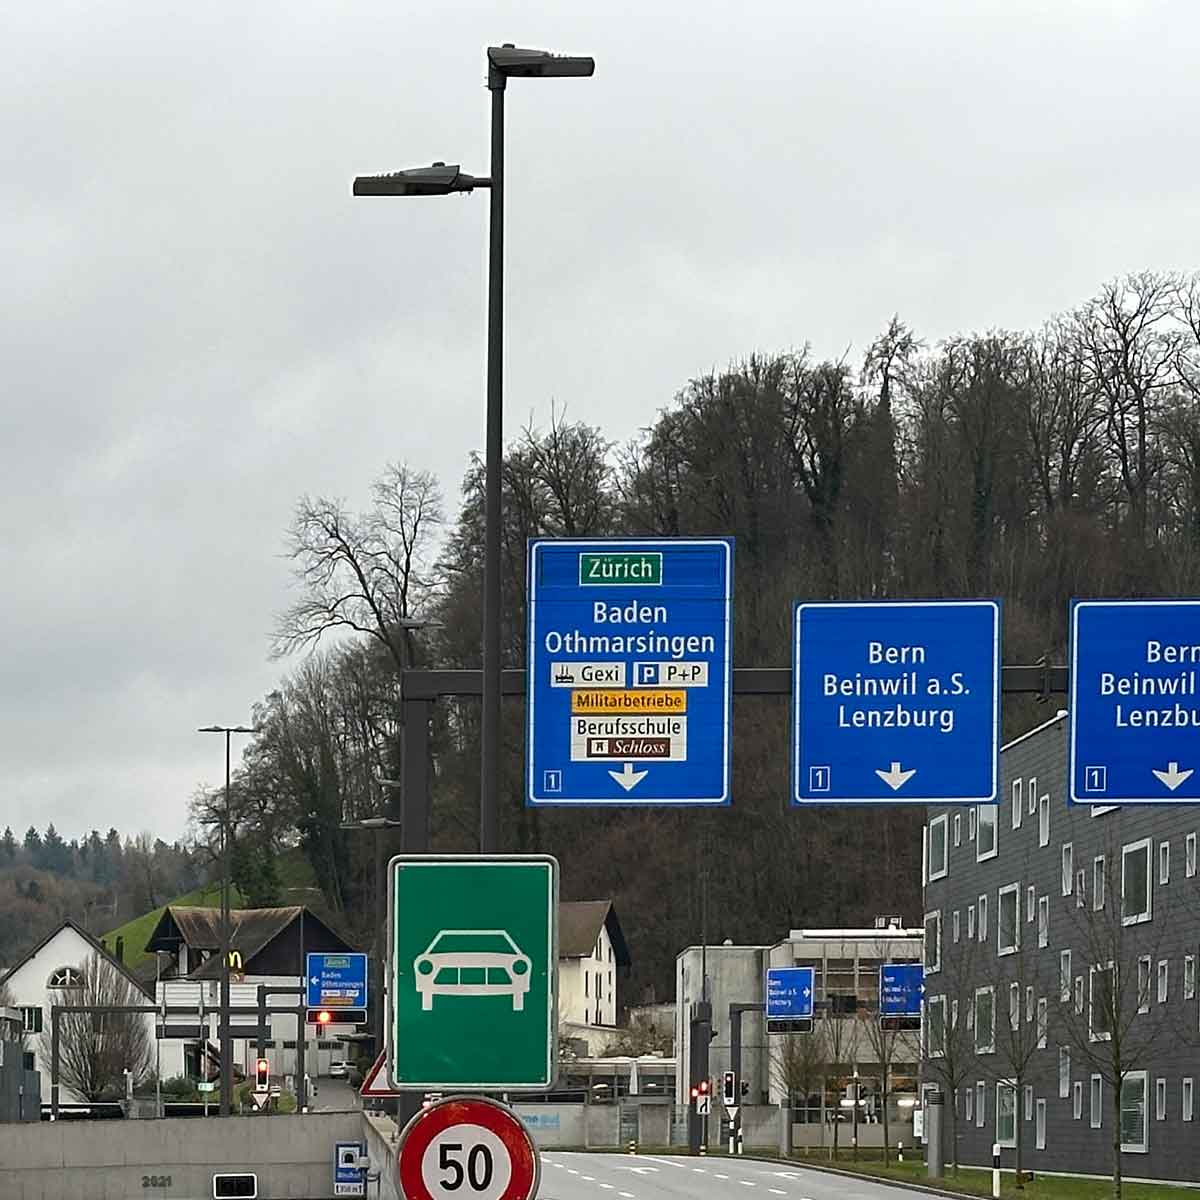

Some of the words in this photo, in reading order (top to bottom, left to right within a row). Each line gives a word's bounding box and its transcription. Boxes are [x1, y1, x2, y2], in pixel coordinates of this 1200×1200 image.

[588, 557, 653, 578] Zürich
[593, 600, 667, 623] Baden
[545, 630, 715, 658] Othmarsingen
[868, 642, 926, 664] Bern
[1147, 641, 1200, 663] Bern
[581, 665, 620, 682] Gexi
[667, 665, 702, 681] P+P
[1101, 671, 1195, 695] Beinwil
[824, 672, 917, 696] Beinwil
[927, 673, 971, 696] a.S.
[577, 719, 681, 735] Berufsschule
[839, 704, 955, 732] Lenzburg
[614, 740, 666, 754] Schloss
[549, 774, 556, 788] 1
[815, 770, 824, 788] 1
[1091, 770, 1099, 788] 1
[439, 1143, 494, 1192] 50
[142, 1175, 173, 1188] 2021
